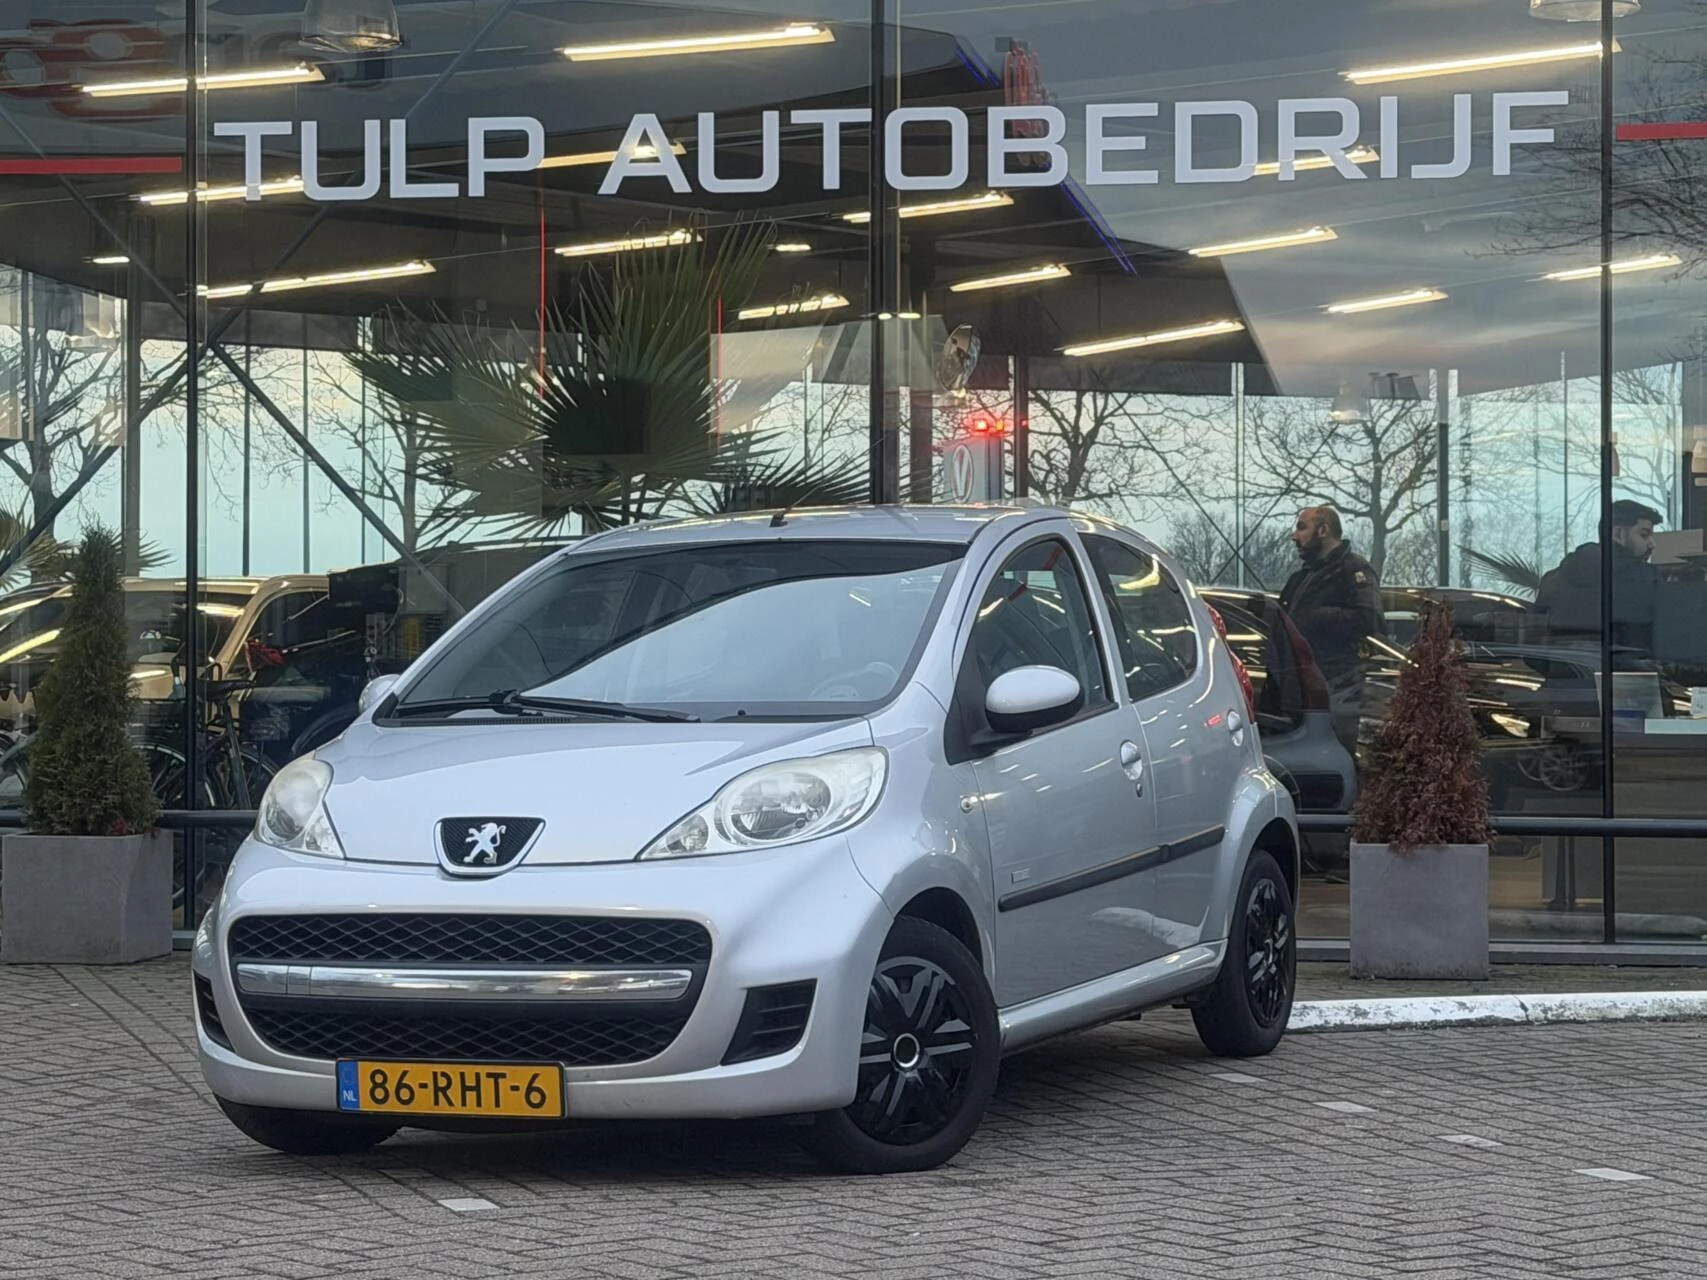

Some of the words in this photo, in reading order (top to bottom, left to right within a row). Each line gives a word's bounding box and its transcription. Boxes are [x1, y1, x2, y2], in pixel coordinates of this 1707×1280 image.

[213, 116, 546, 202] TULP
[597, 90, 1570, 195] AUTOBEDRIJF
[343, 1089, 358, 1102] NL
[369, 1068, 547, 1110] 86-RHT-6
